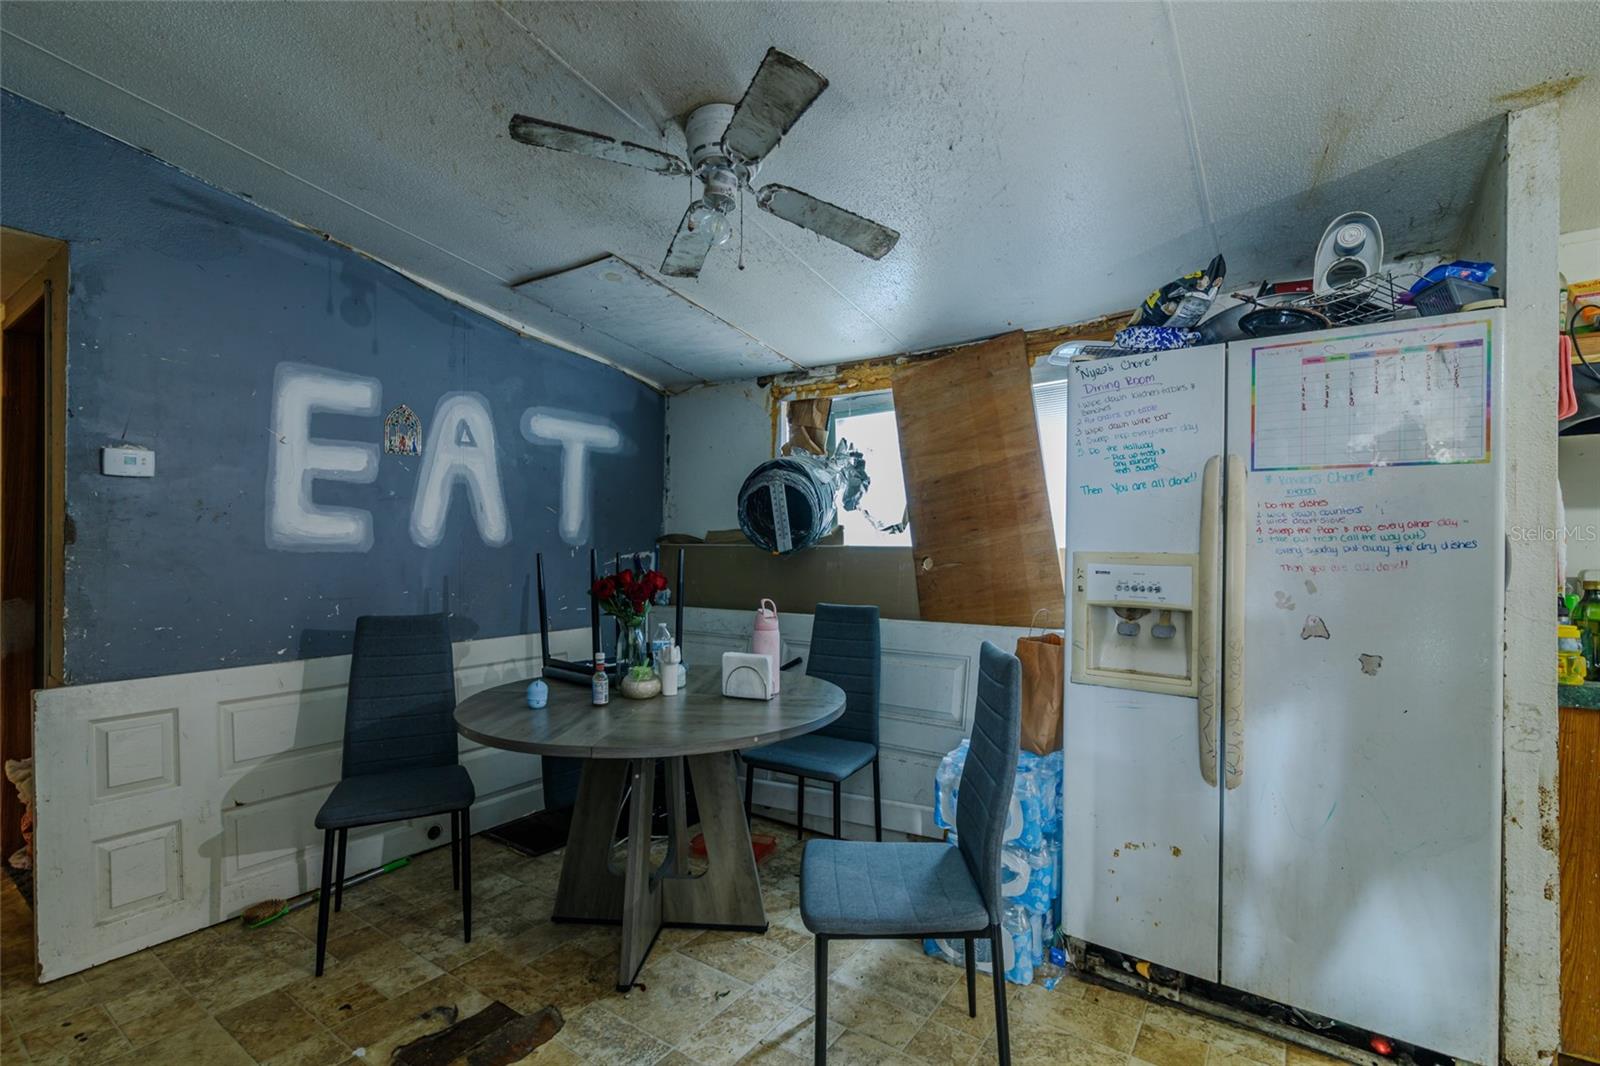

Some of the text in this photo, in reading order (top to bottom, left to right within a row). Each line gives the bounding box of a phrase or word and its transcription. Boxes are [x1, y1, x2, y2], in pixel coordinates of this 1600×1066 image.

[1083, 374, 1155, 394] Dining Room
[266, 361, 624, 551] EAT
[1080, 484, 1103, 495] Then
[1131, 480, 1147, 491] are
[1151, 479, 1166, 488] all
[1299, 499, 1329, 509] dishes
[1319, 505, 1365, 517] counters
[1379, 532, 1401, 544] way
[1416, 541, 1438, 554] dry
[1441, 538, 1479, 552] dishes
